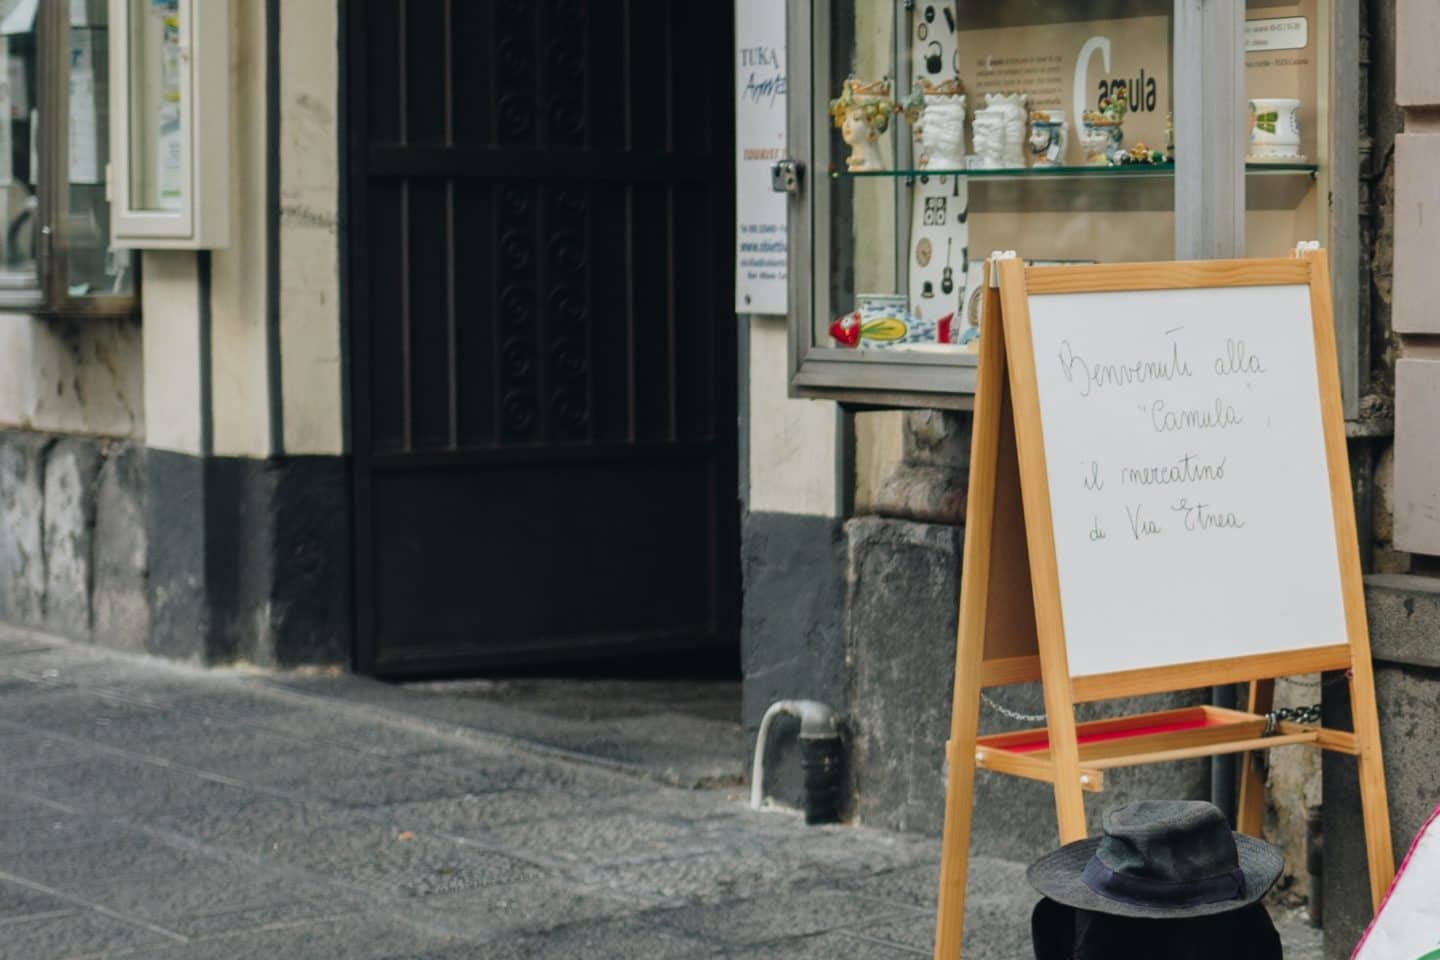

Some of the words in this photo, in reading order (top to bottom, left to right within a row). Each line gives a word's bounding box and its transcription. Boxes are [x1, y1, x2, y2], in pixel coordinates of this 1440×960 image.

[1058, 326, 1192, 397] Benvenuti
[1214, 337, 1267, 376] alla
[1080, 460, 1105, 490] il
[1121, 452, 1227, 485] mercatino
[1089, 514, 1106, 541] di
[1125, 503, 1161, 540] Via
[1170, 498, 1246, 532] Etnea
